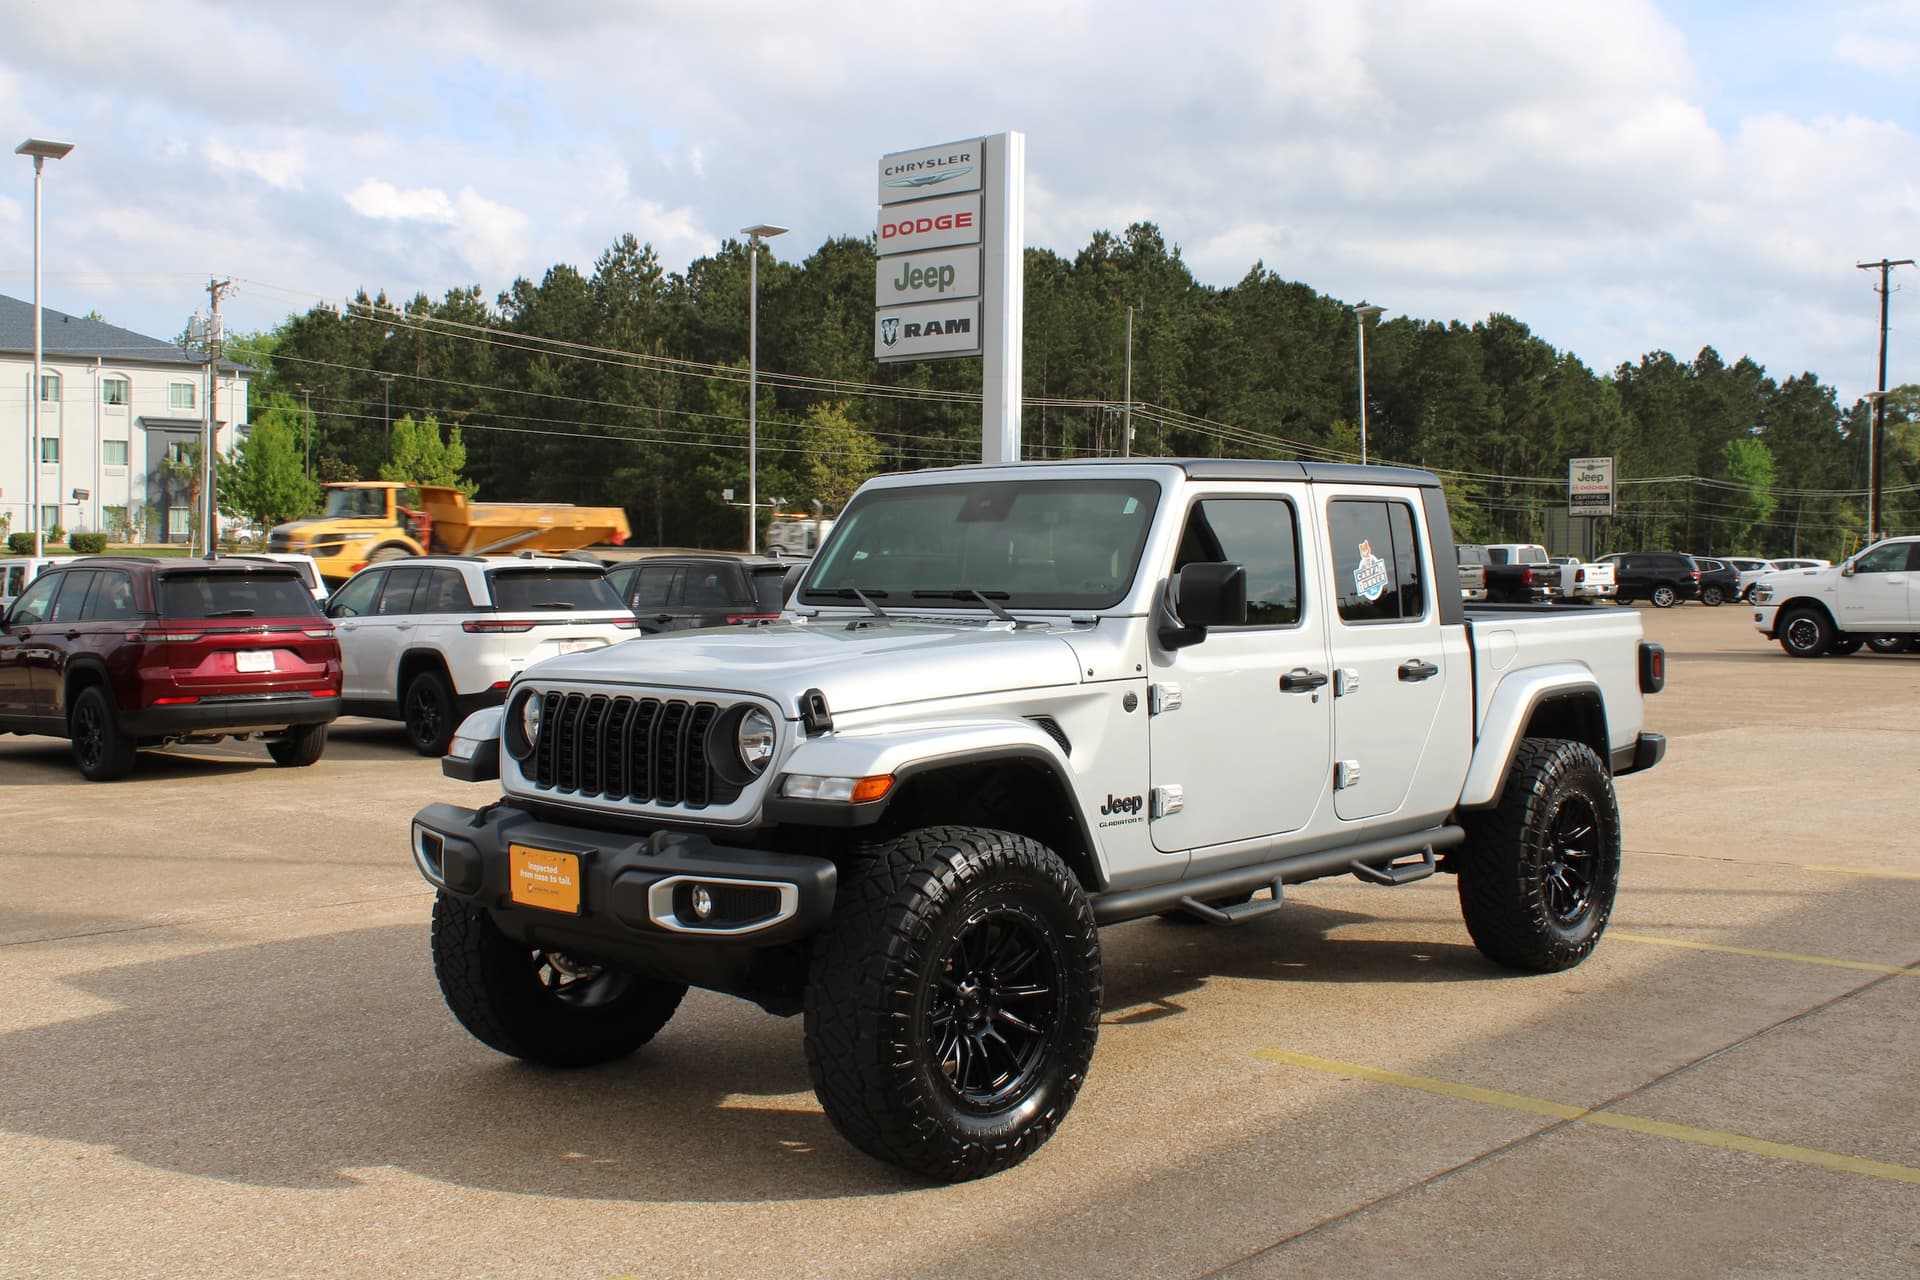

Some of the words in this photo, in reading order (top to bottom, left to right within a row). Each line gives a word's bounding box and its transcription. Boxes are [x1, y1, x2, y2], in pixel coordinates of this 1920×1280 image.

[884, 153, 971, 176] CHRYSLER
[882, 212, 973, 239] DODGE
[894, 262, 955, 293] Jeep
[904, 318, 971, 338] RAM
[1577, 472, 1604, 484] Jeep
[1100, 794, 1143, 815] Jeep
[1099, 818, 1137, 828] GLADIATOR
[520, 868, 534, 878] from
[550, 875, 558, 883] to
[528, 861, 558, 873] Inspected
